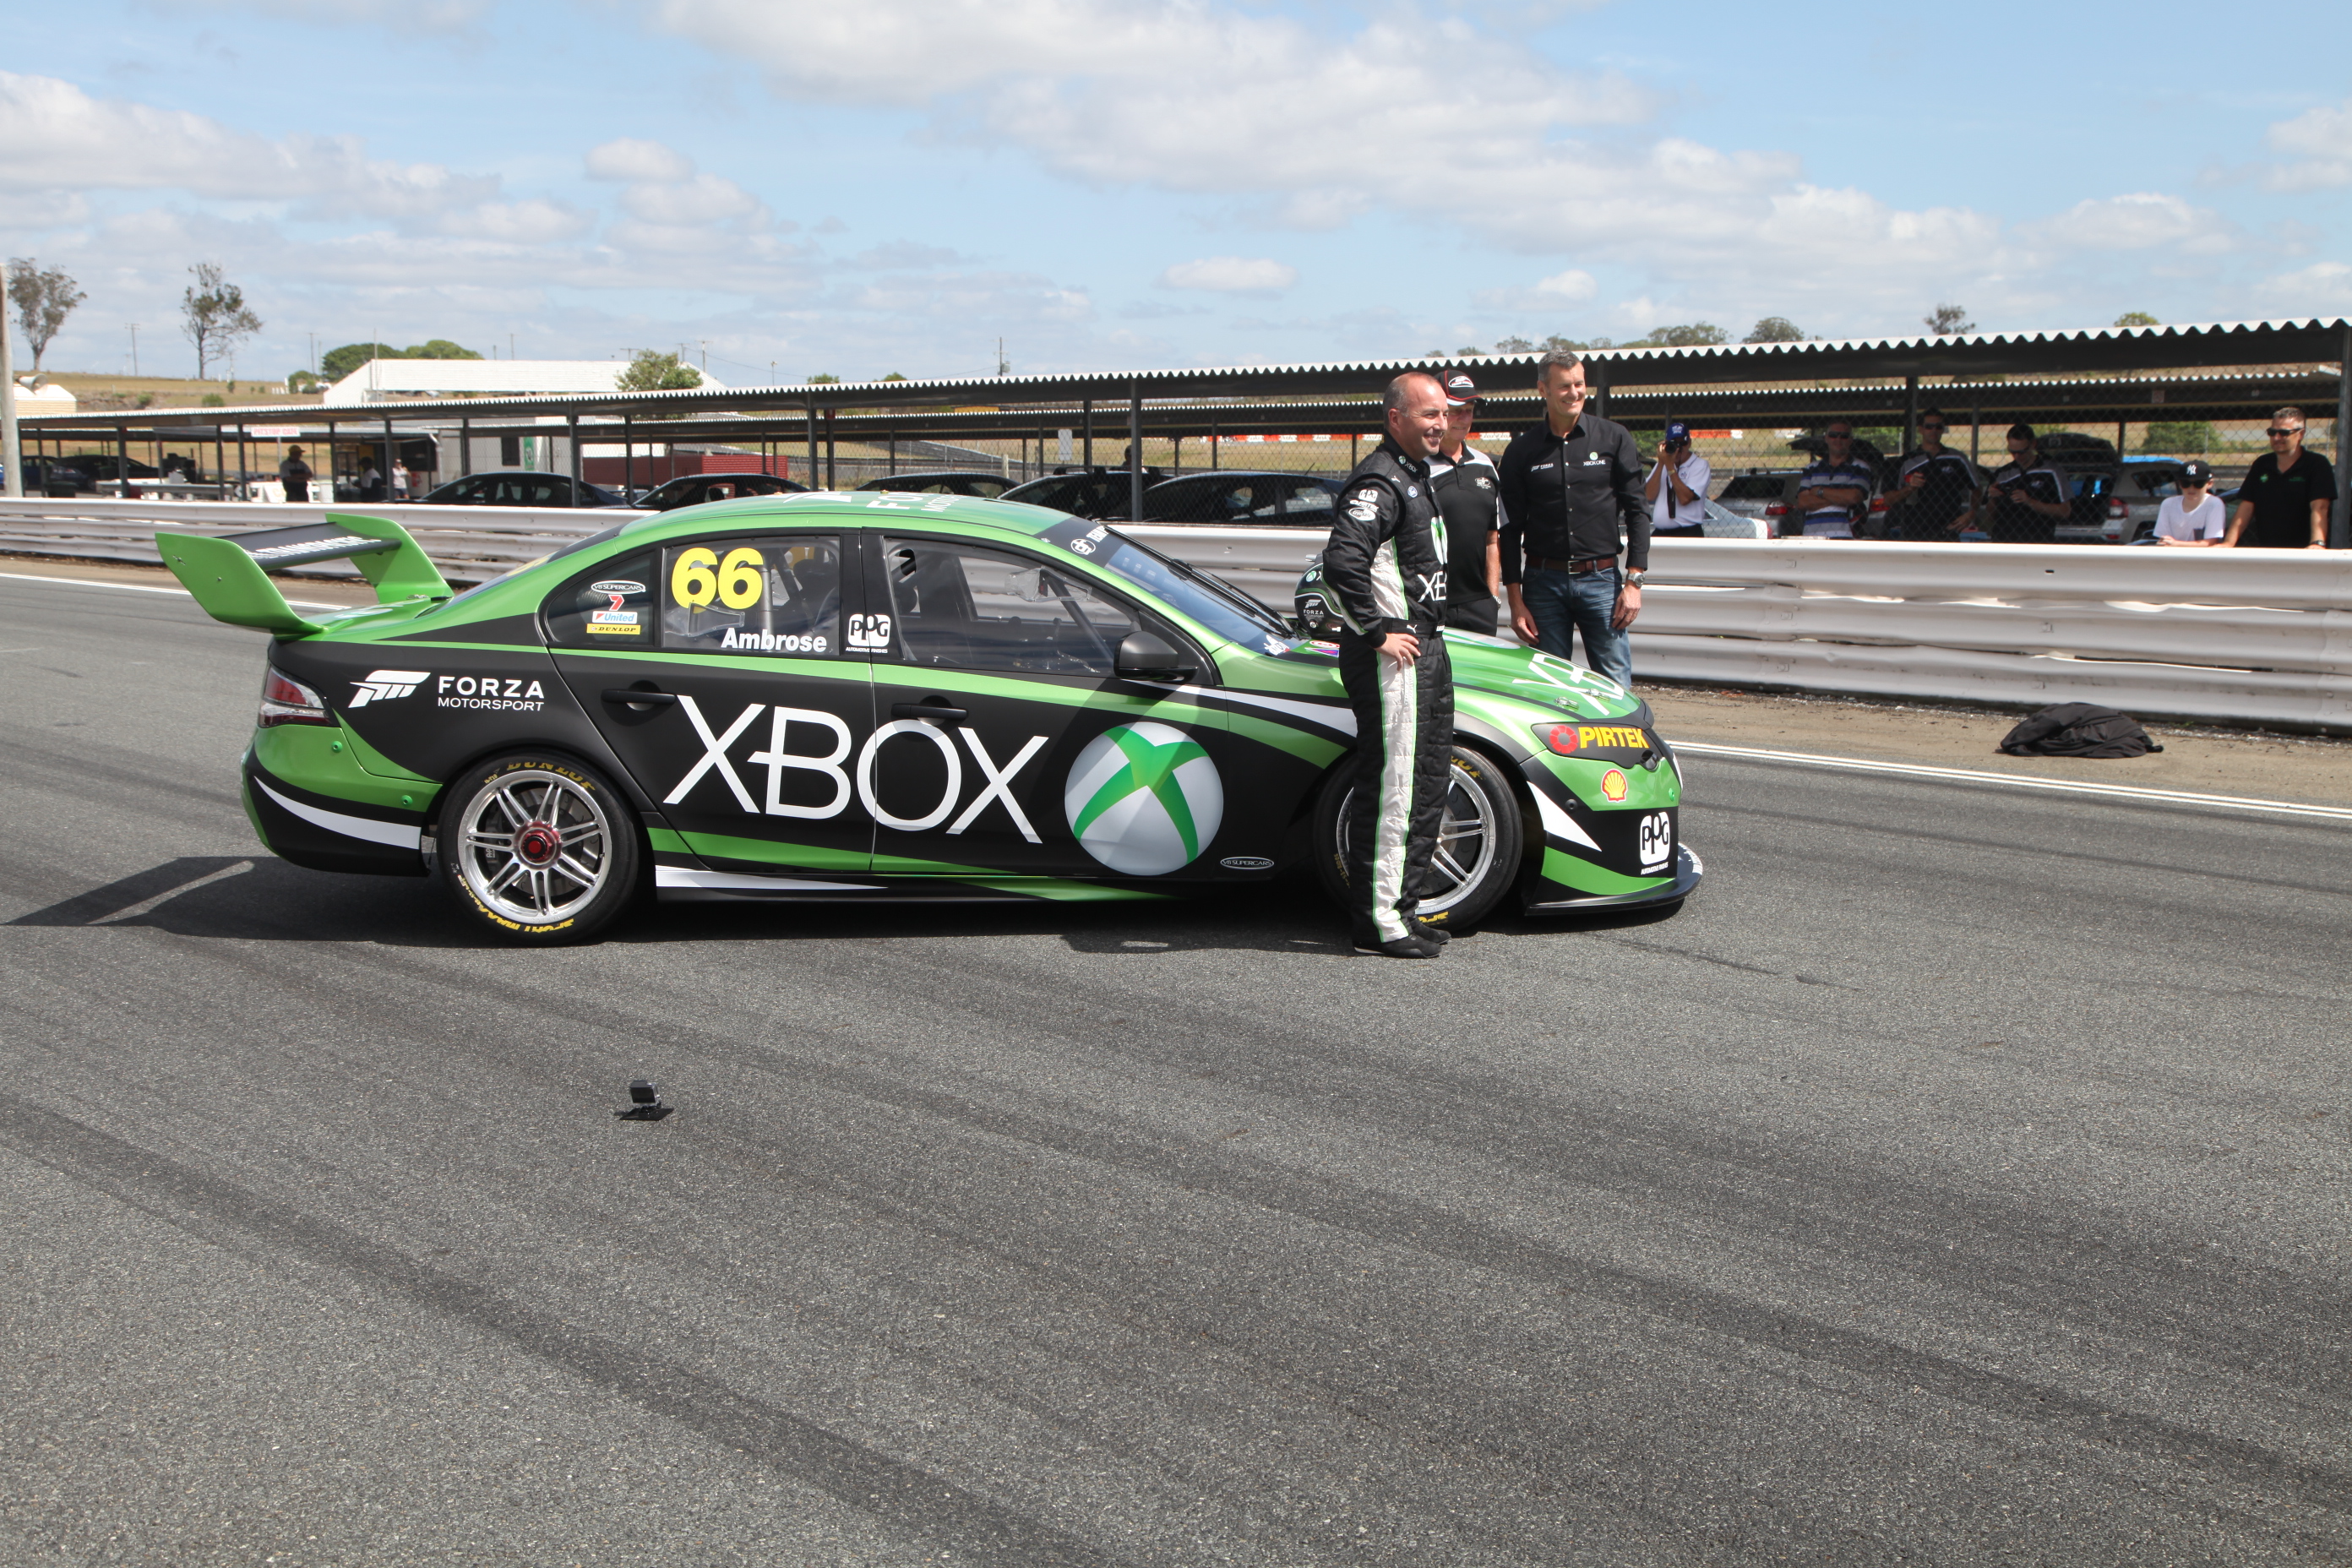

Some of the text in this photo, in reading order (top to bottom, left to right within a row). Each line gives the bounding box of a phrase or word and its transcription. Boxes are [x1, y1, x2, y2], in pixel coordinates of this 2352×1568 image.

[671, 547, 764, 612] 66
[604, 612, 635, 622] United
[850, 613, 890, 641] PPG
[721, 627, 827, 653] Ambrose
[438, 676, 545, 700] FORZA
[438, 698, 545, 711] MOTORSPORT
[1577, 726, 1649, 749] PIRTEK
[662, 695, 1049, 845] XBOX
[1642, 813, 1669, 855] PPG
